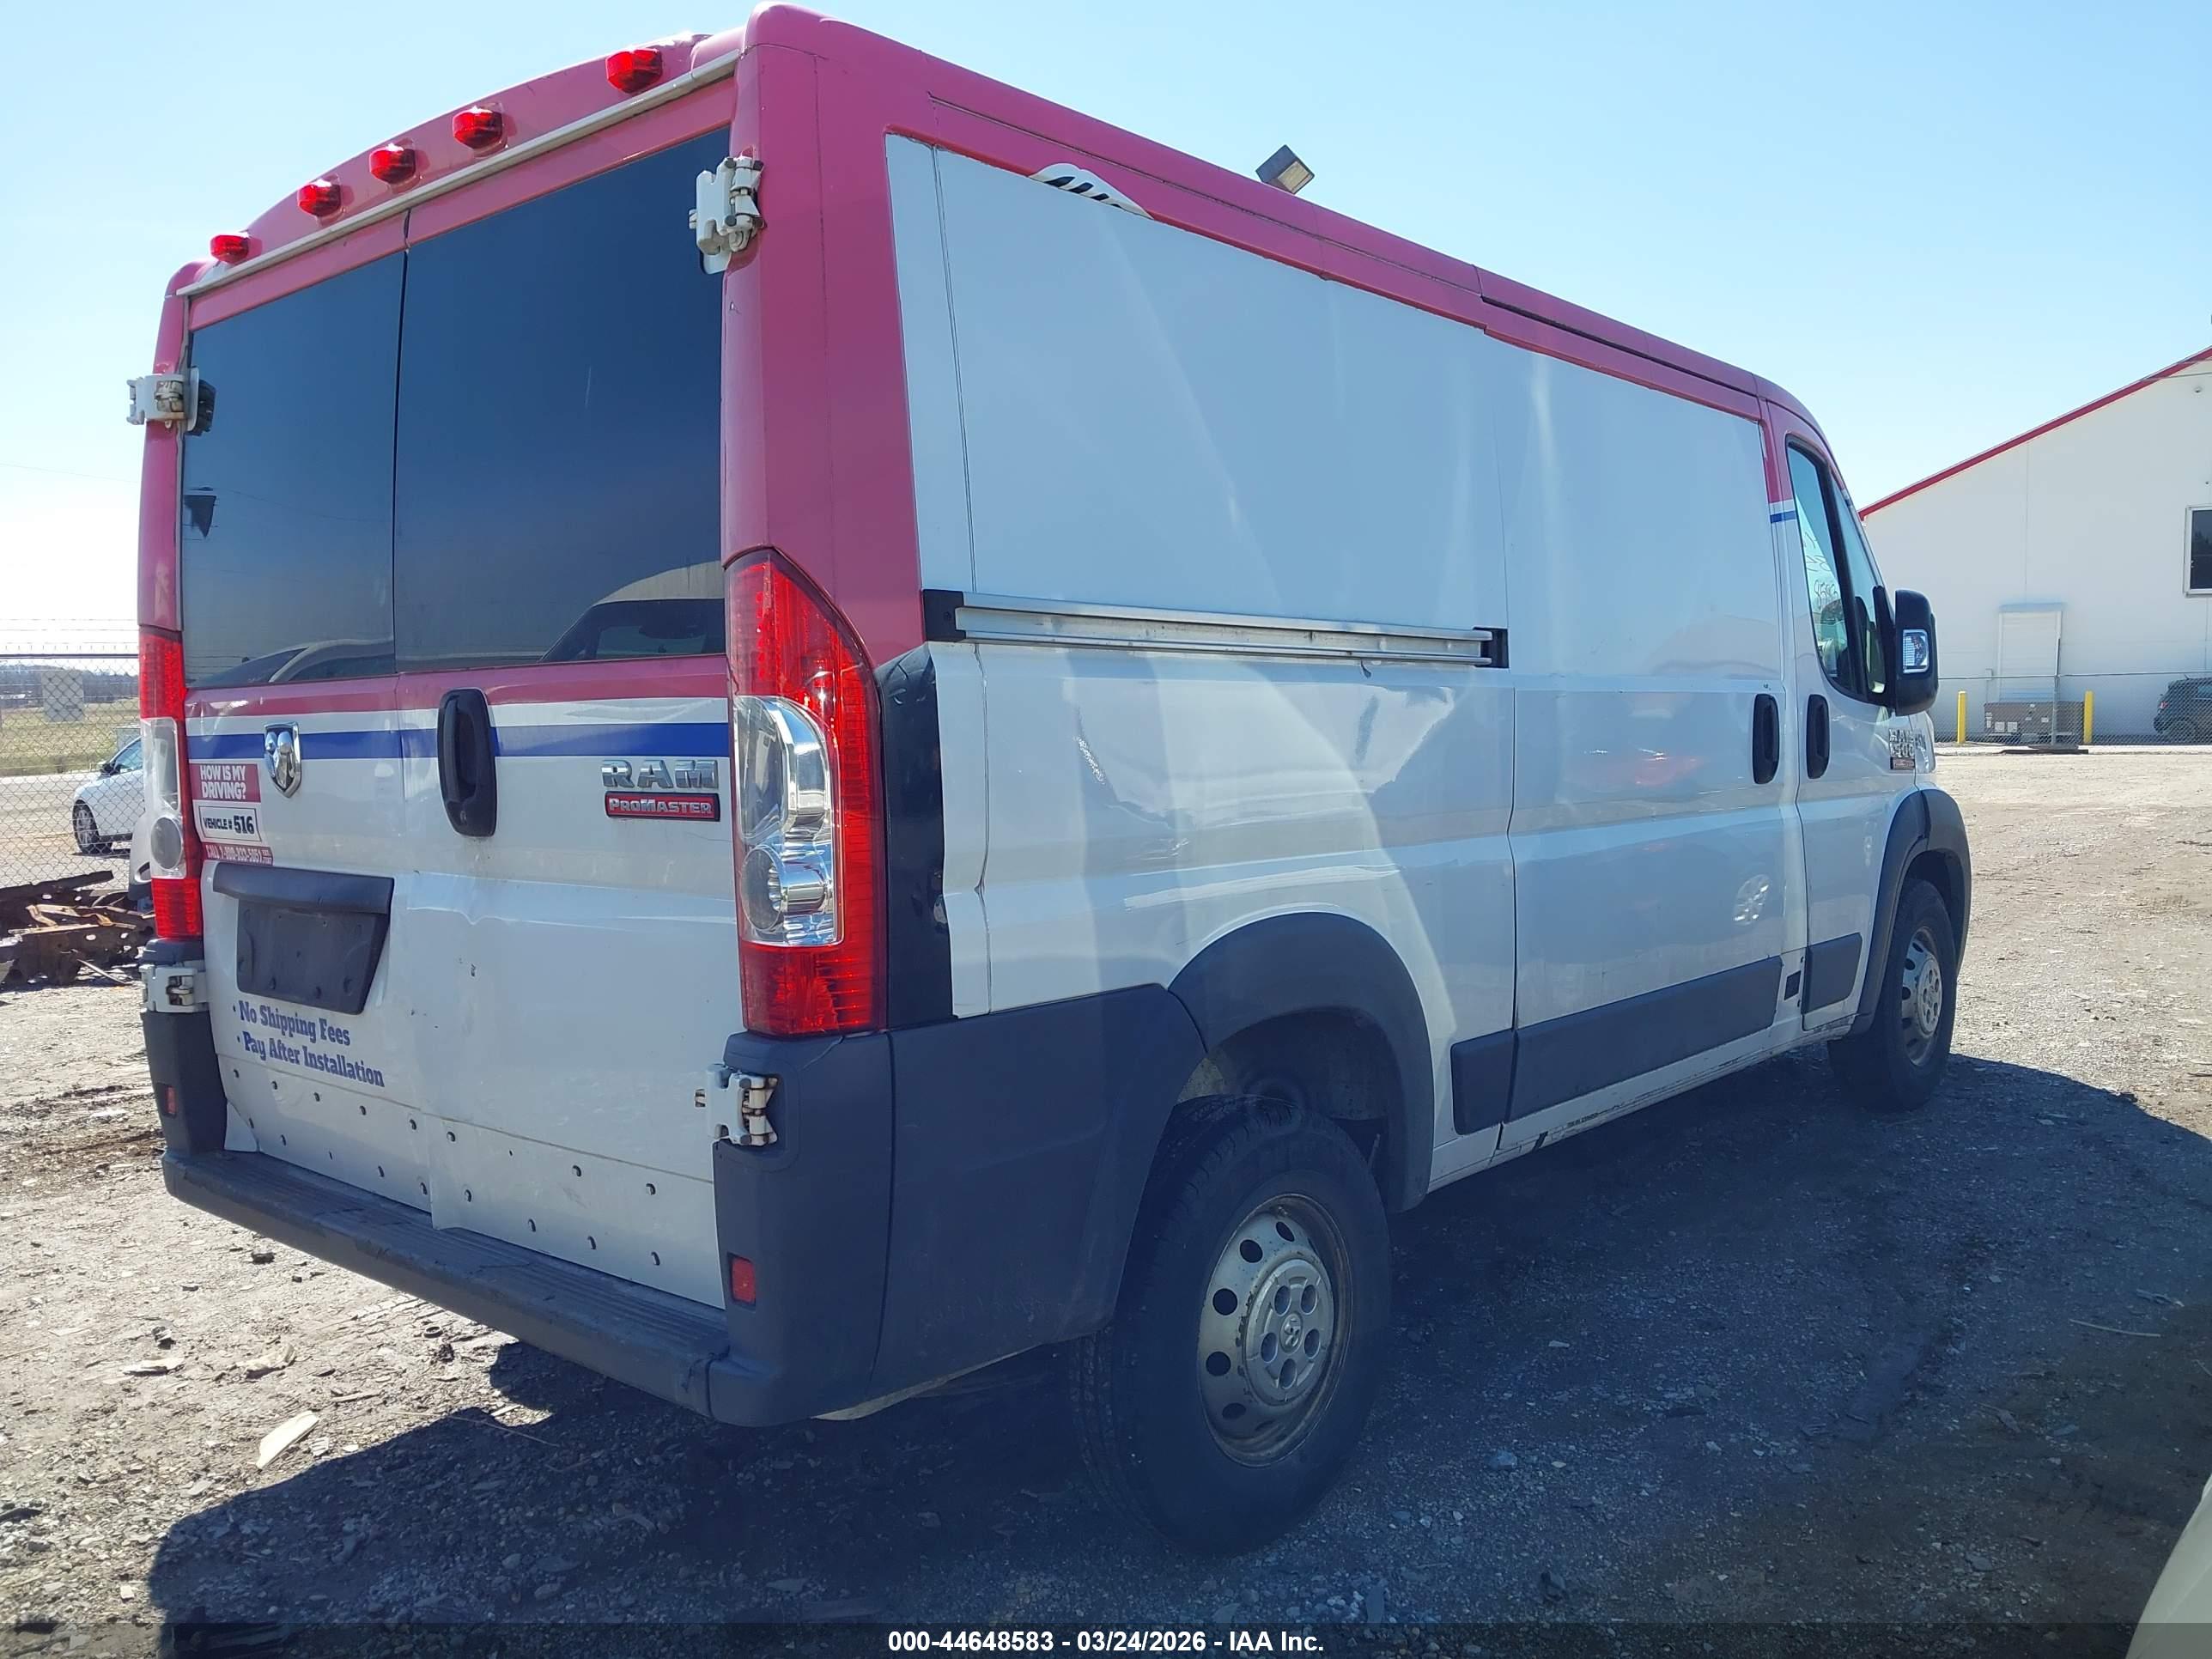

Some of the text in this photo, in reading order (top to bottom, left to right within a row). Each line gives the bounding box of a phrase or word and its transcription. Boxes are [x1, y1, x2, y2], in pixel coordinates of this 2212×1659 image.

[199, 764, 246, 781] HOW IS MY
[601, 759, 719, 789] RAM
[201, 781, 246, 799] DRIVING?
[203, 817, 228, 830] VEHICLE
[234, 815, 255, 835] 516
[205, 844, 221, 860] CALL
[239, 1000, 350, 1046] No Shipping Fees
[242, 1030, 386, 1088] Pay After Installation
